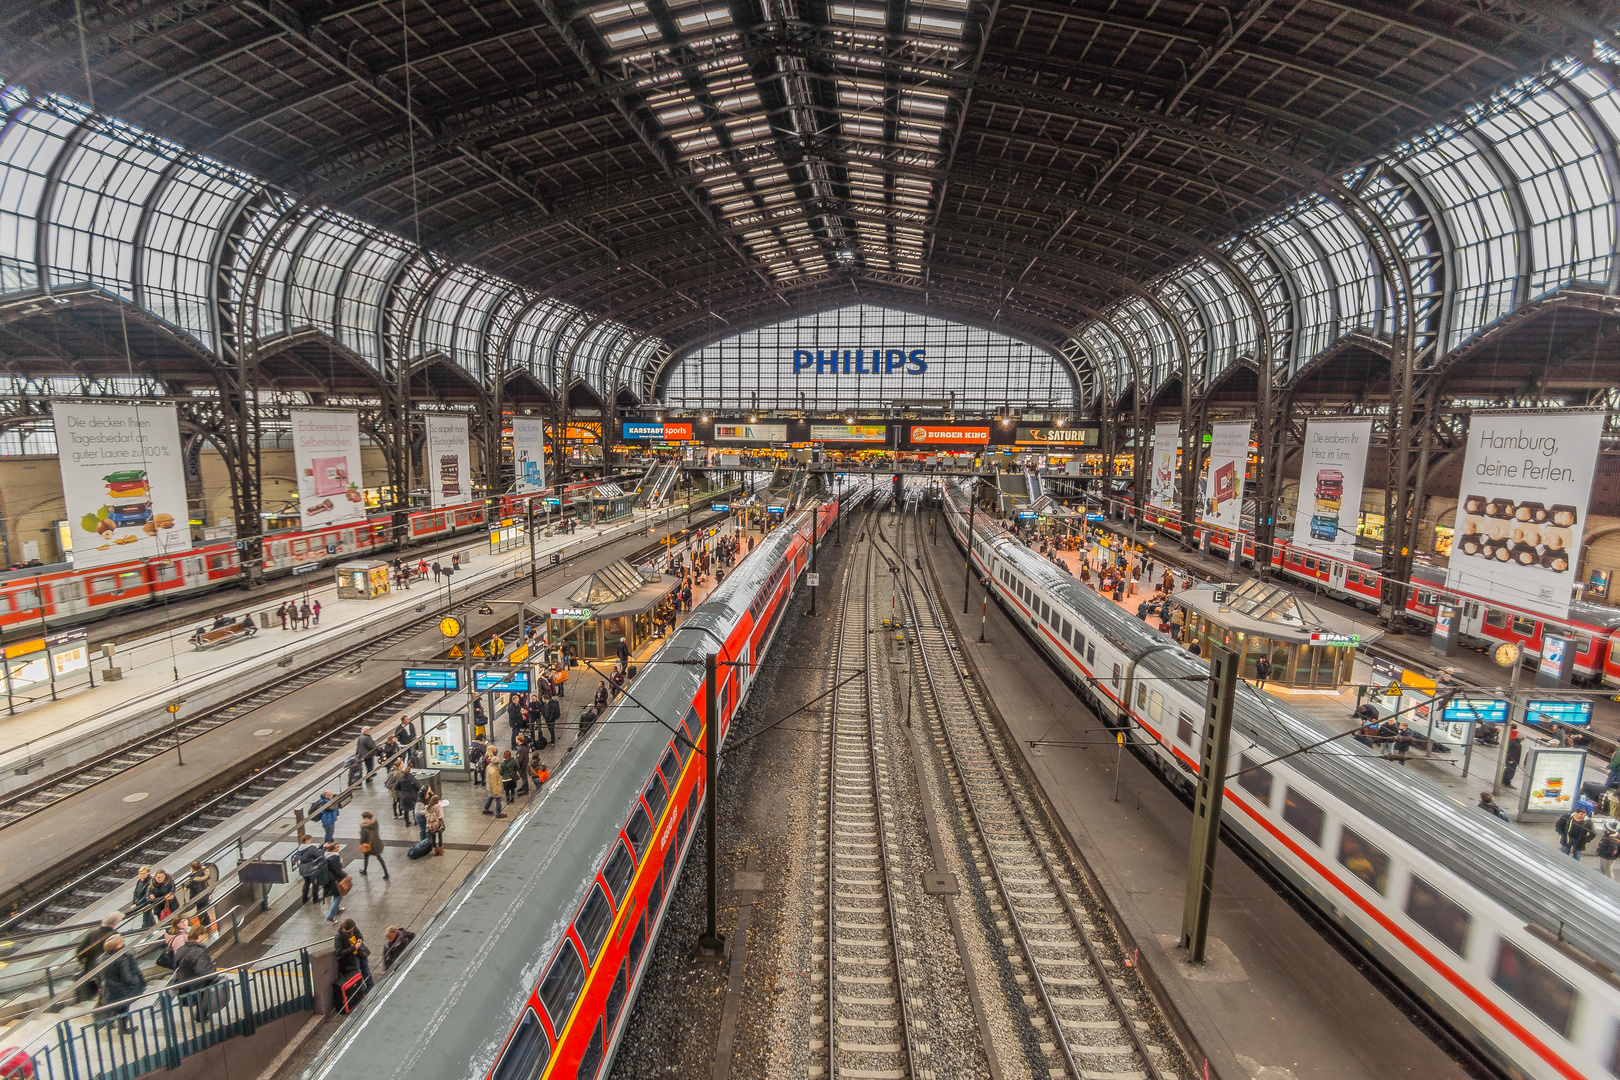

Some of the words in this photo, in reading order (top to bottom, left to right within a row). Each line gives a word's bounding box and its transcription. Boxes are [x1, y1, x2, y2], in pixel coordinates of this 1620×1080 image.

[793, 349, 928, 375] PHILIPS
[67, 416, 86, 428] Die
[89, 416, 126, 428] decken
[128, 416, 151, 428] Ihren
[665, 427, 687, 435] sports
[1047, 430, 1086, 441] SATURN
[70, 431, 134, 446] Tagesbedarf
[136, 435, 148, 443] an
[1313, 432, 1324, 443] Die
[1325, 433, 1350, 444] erobern
[1350, 432, 1360, 444] Ihr
[1480, 429, 1559, 457] Hamburg,
[72, 450, 98, 462] guter
[100, 447, 129, 459] Laune
[1311, 448, 1326, 459] Herz
[1327, 449, 1335, 460] im
[1476, 456, 1517, 478] deine
[1522, 459, 1575, 482] Perlen.
[551, 554, 556, 562] E
[1215, 592, 1222, 600] E
[1430, 594, 1437, 604] E
[1507, 613, 1513, 621] 2
